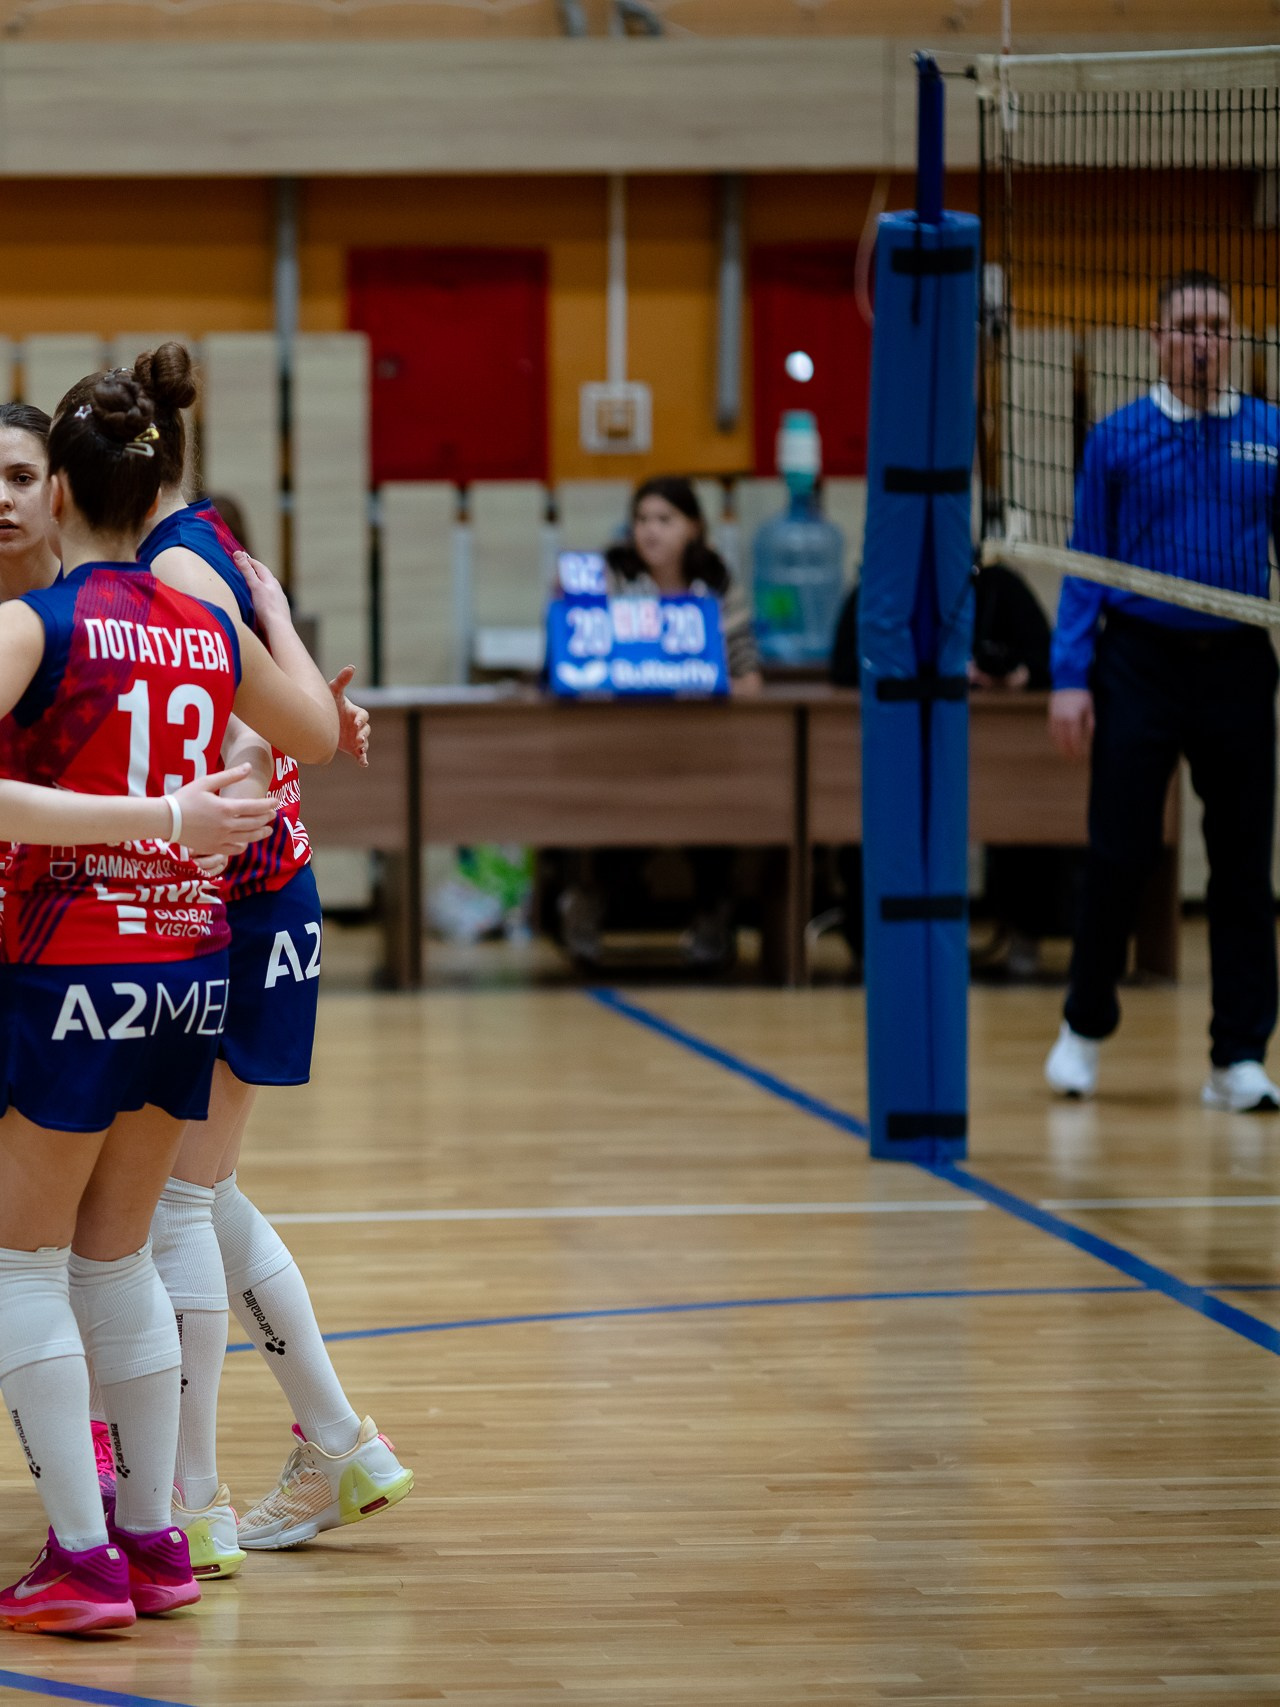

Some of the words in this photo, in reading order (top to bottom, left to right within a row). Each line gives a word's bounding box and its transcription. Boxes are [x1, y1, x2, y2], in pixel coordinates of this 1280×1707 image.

[84, 618, 230, 674] ПОТАТУЕВА
[118, 680, 215, 798] 13
[153, 908, 214, 925] GLOBAL
[155, 922, 211, 938] VISION
